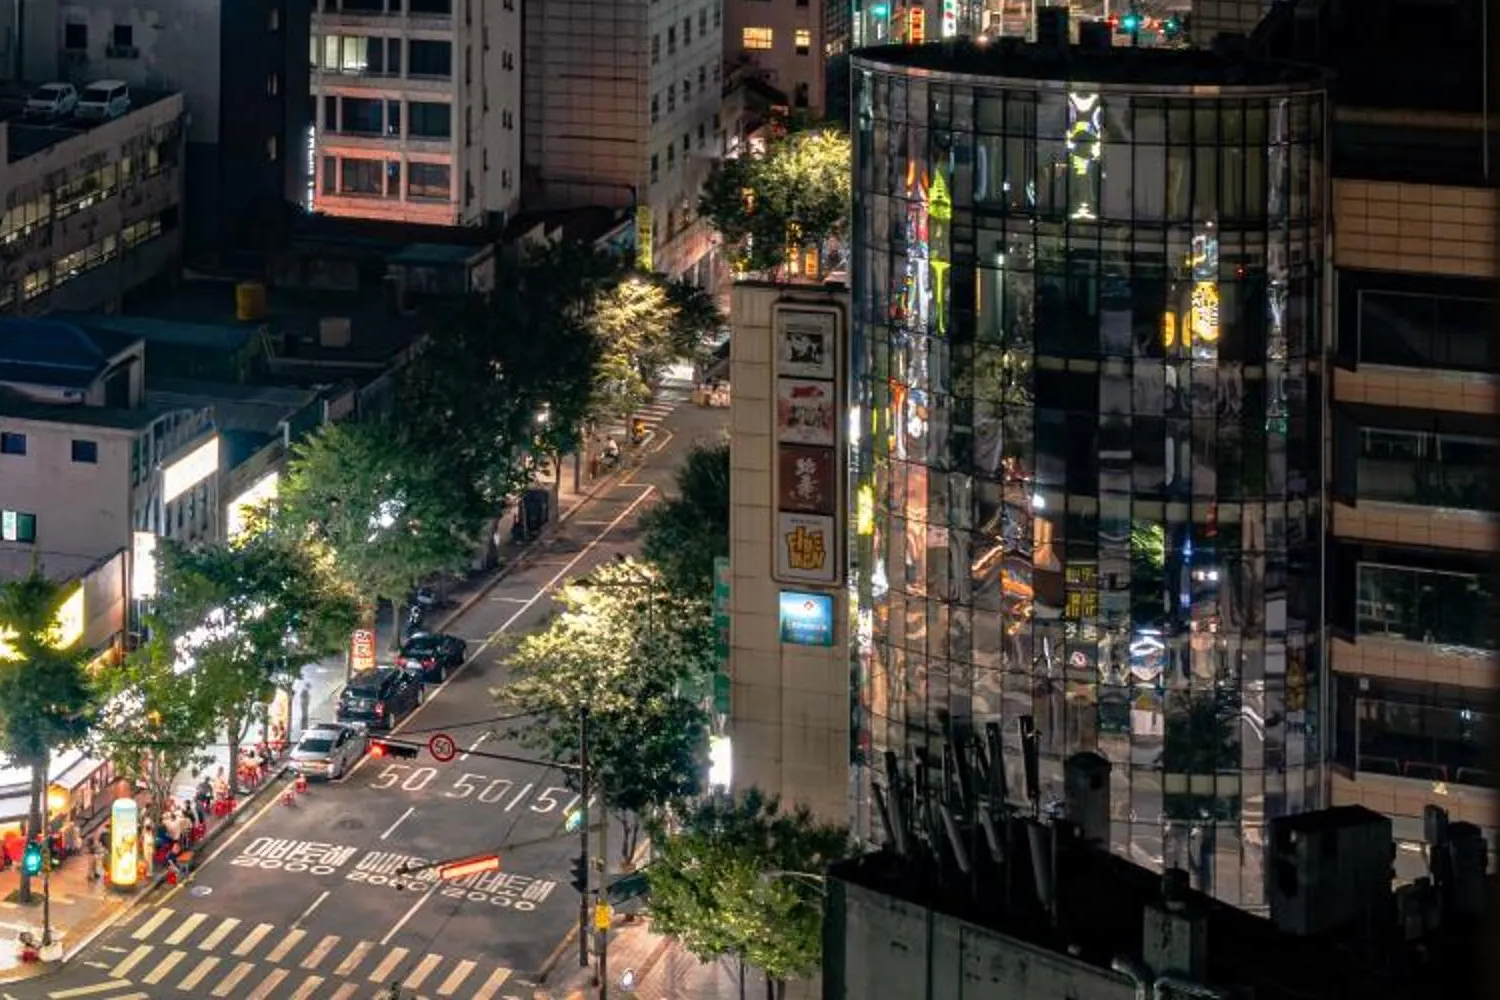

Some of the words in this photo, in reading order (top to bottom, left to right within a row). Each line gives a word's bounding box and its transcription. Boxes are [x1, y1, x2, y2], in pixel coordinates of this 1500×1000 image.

[369, 763, 439, 792] 50
[444, 772, 514, 804] 50
[231, 836, 358, 876] 일방통행
